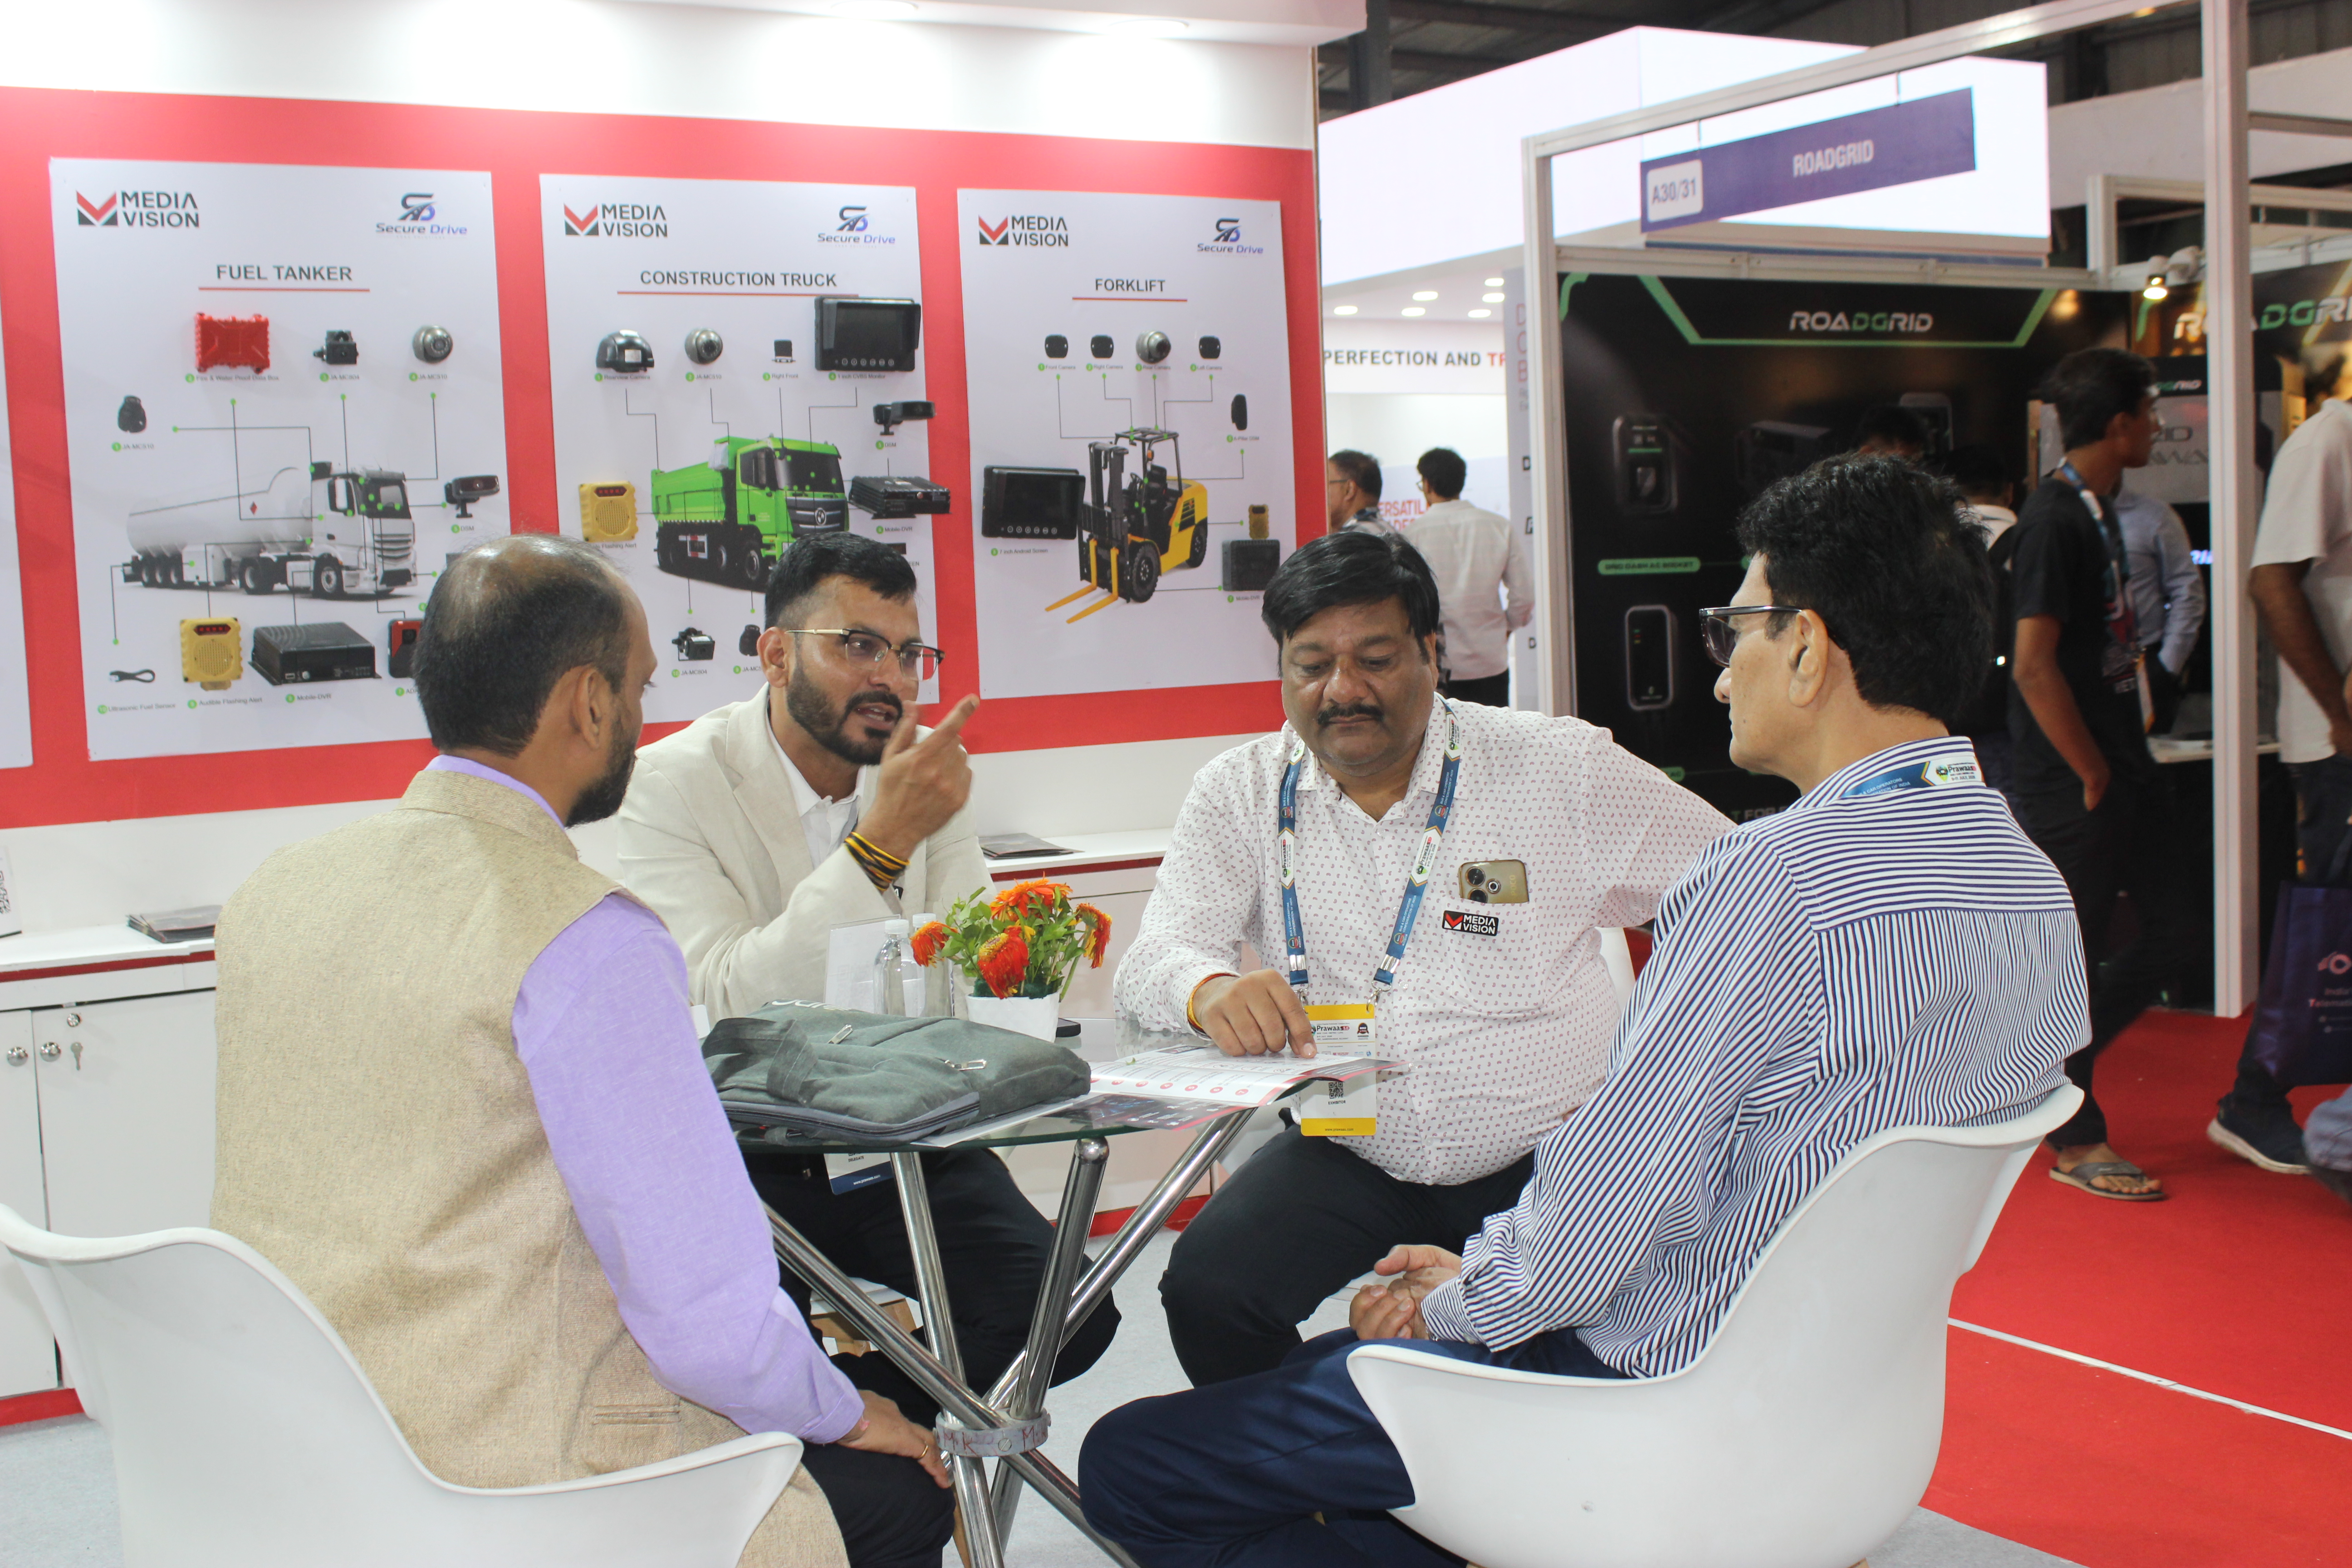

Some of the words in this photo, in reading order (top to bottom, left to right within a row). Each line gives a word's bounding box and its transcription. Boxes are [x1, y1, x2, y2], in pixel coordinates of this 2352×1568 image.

[1793, 139, 1875, 177] ROADGRID
[1652, 178, 1696, 204] A30/31
[121, 190, 198, 209] MEDIA
[122, 211, 200, 227] VISION
[602, 203, 666, 220] MEDIA
[376, 222, 426, 233] Secure
[430, 224, 467, 234] Drive
[603, 221, 668, 237] VISION
[1012, 215, 1068, 230] MEDIA
[817, 233, 860, 242] Secure
[864, 234, 896, 244] Drive
[1013, 232, 1068, 246] VISION
[1197, 243, 1233, 252] Secure
[1236, 245, 1264, 253] Drive
[216, 265, 268, 280] FUEL
[273, 265, 353, 281] TANKER
[640, 270, 775, 286] CONSTRUCTION
[780, 272, 837, 287] TRUCK
[1095, 278, 1166, 292] FORKLIFT
[1789, 311, 1934, 332] ROADGRID
[1324, 350, 1437, 365] PERFECTION
[1445, 352, 1481, 366] AND
[1877, 777, 1903, 790] OPERATORS
[1419, 841, 1430, 865] Prawaas
[1404, 898, 1412, 916] OPERATORS
[1402, 908, 1412, 932] CONFEDERATION
[1463, 914, 1495, 926] MEDIA
[1463, 923, 1495, 935] VISION
